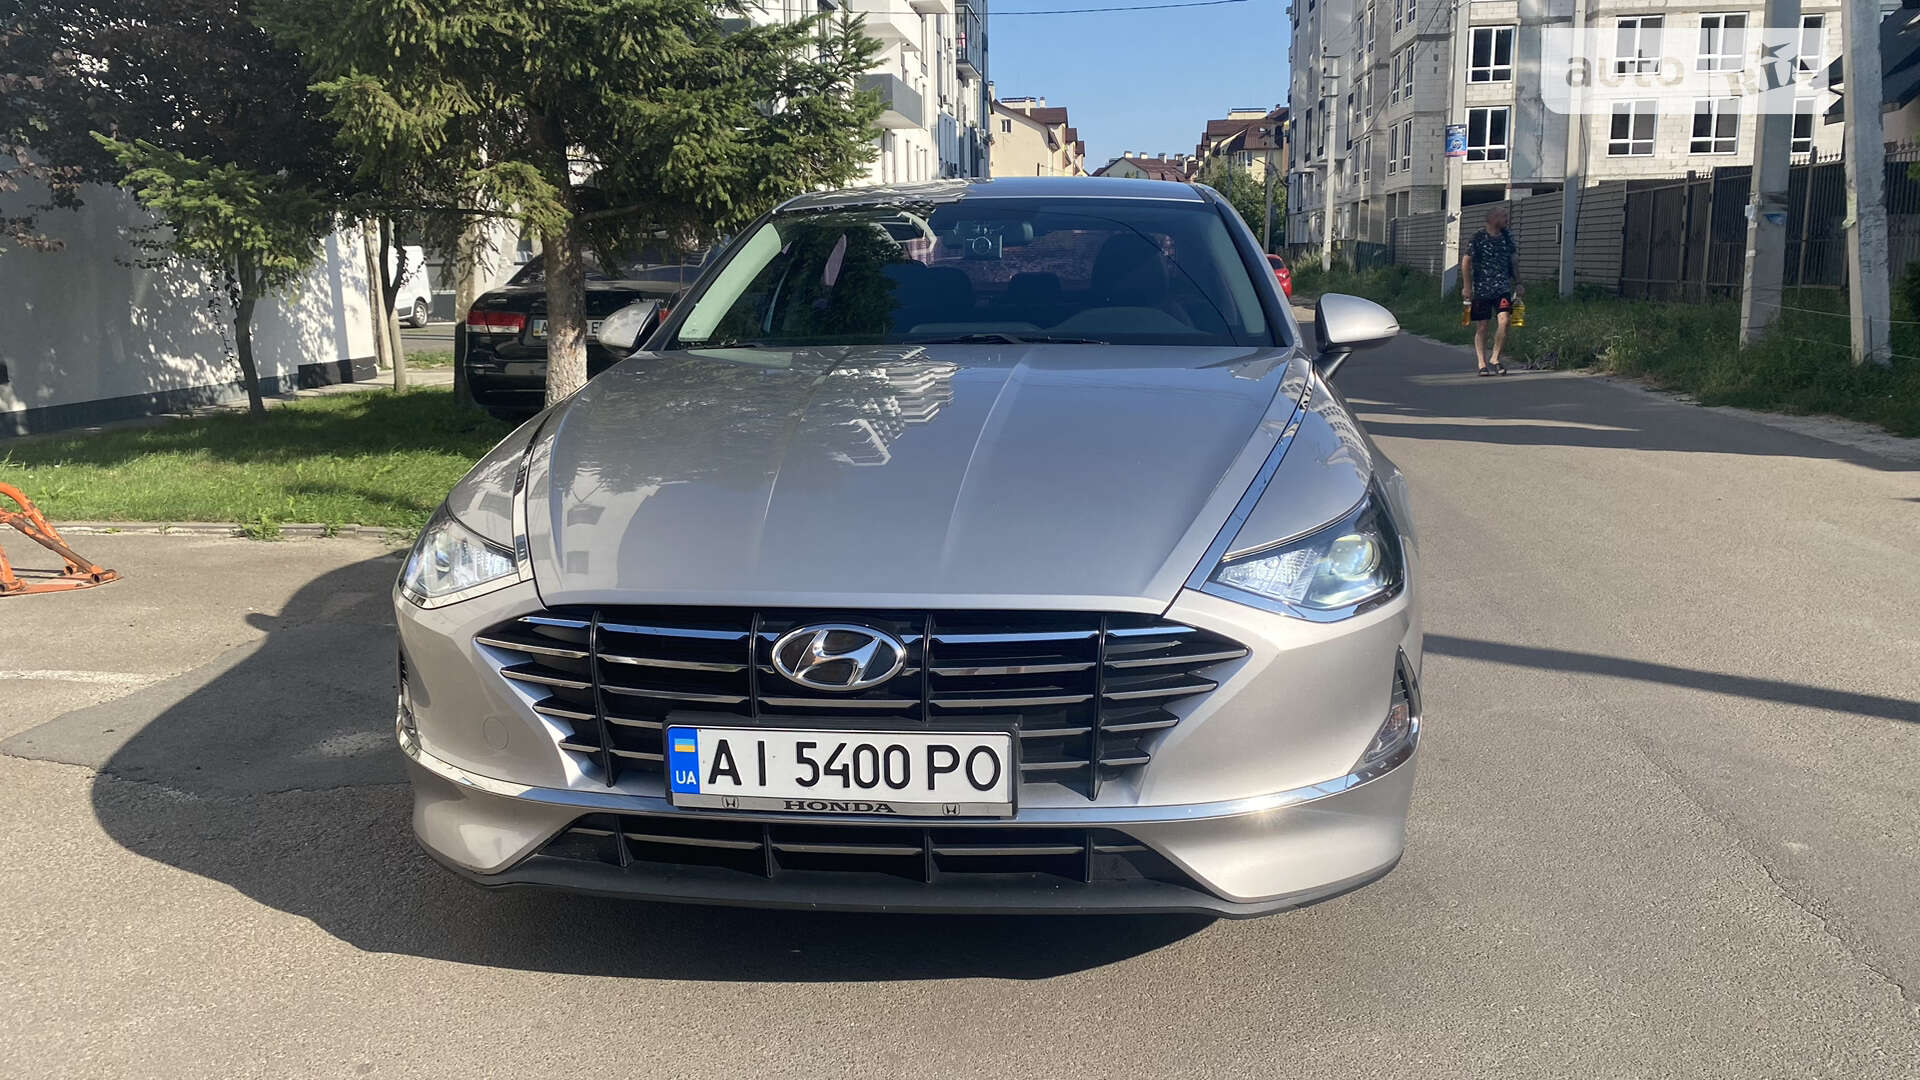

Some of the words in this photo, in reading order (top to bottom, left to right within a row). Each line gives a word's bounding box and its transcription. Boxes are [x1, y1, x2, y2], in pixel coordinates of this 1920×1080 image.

[708, 738, 767, 788] AI
[795, 741, 912, 791] 5400
[927, 744, 1002, 792] PO
[676, 771, 697, 785] UA
[783, 799, 897, 814] HONDA
